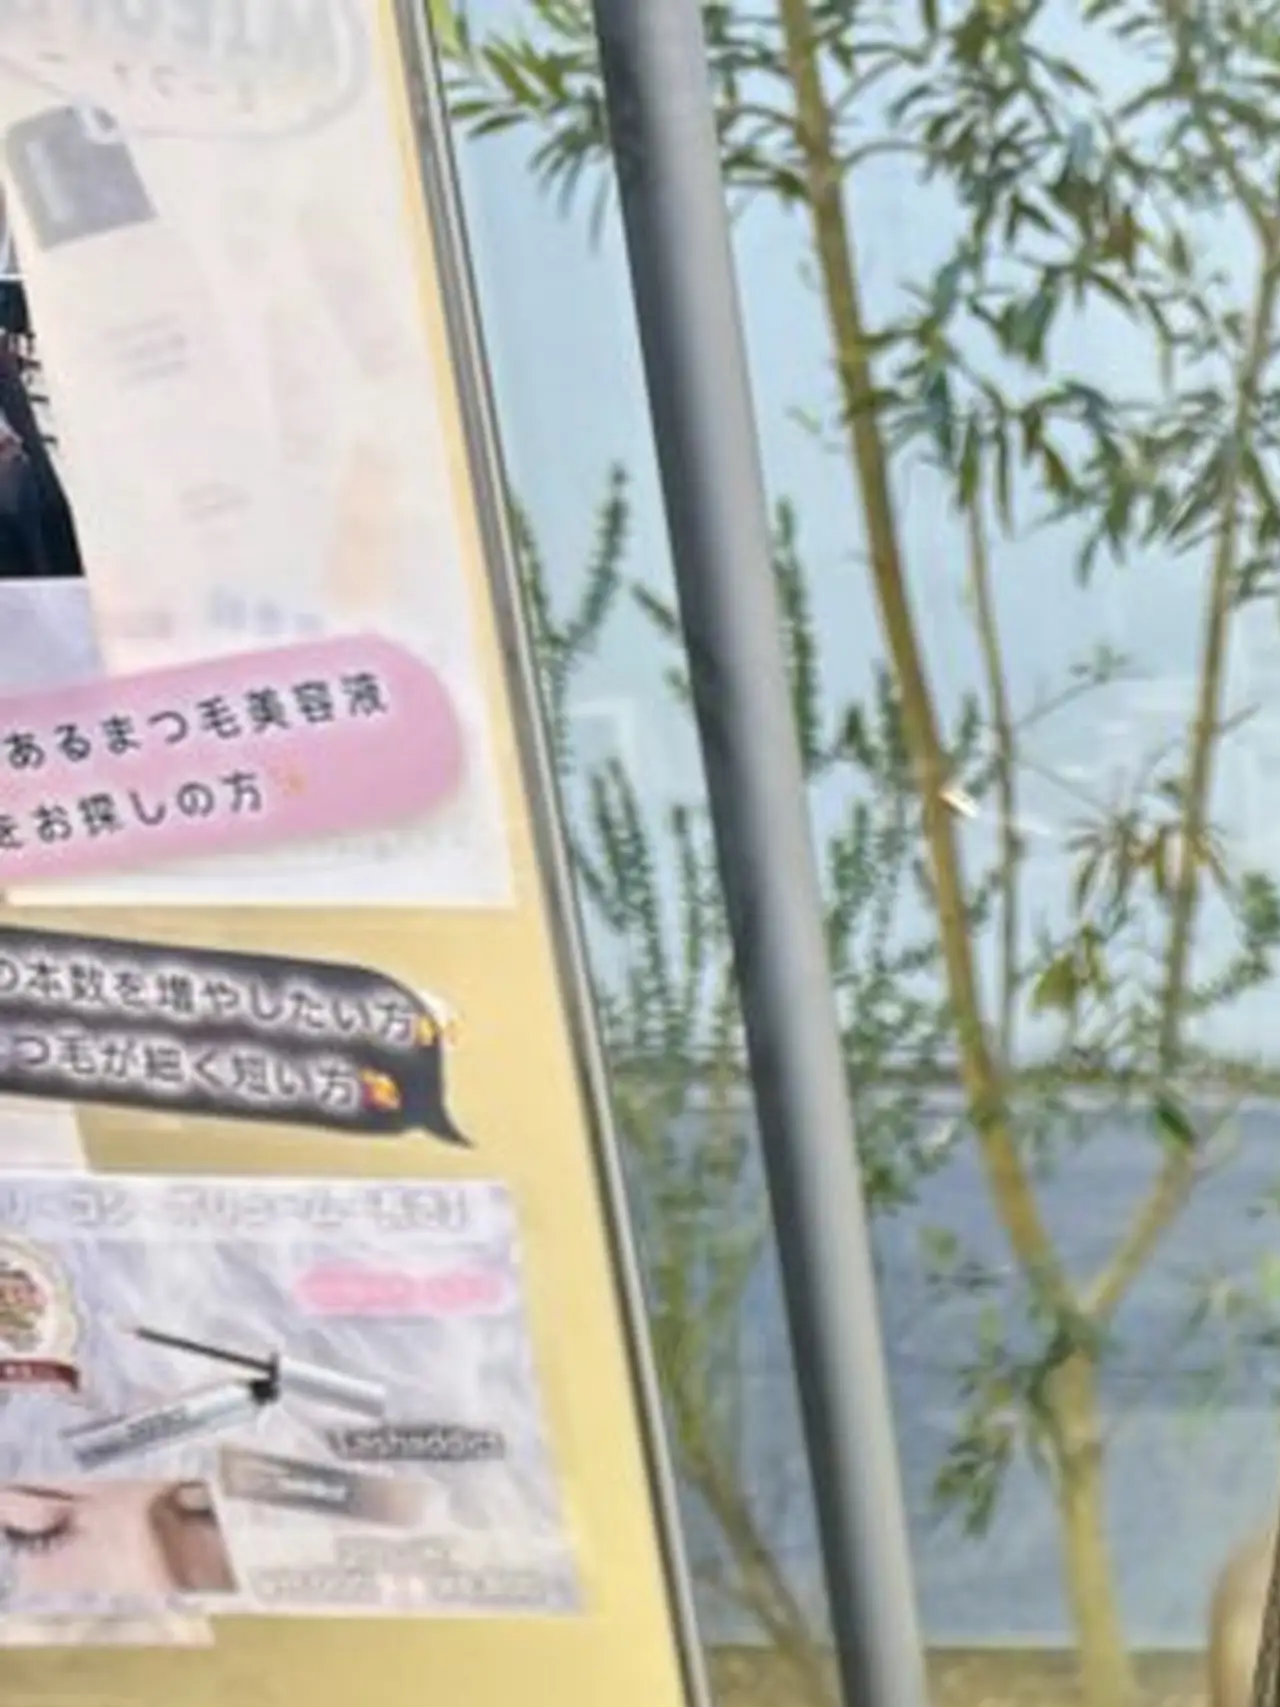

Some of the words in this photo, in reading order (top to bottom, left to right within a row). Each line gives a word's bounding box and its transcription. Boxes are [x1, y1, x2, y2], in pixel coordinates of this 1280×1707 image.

[4, 672, 388, 770] あるまつ毛美容液
